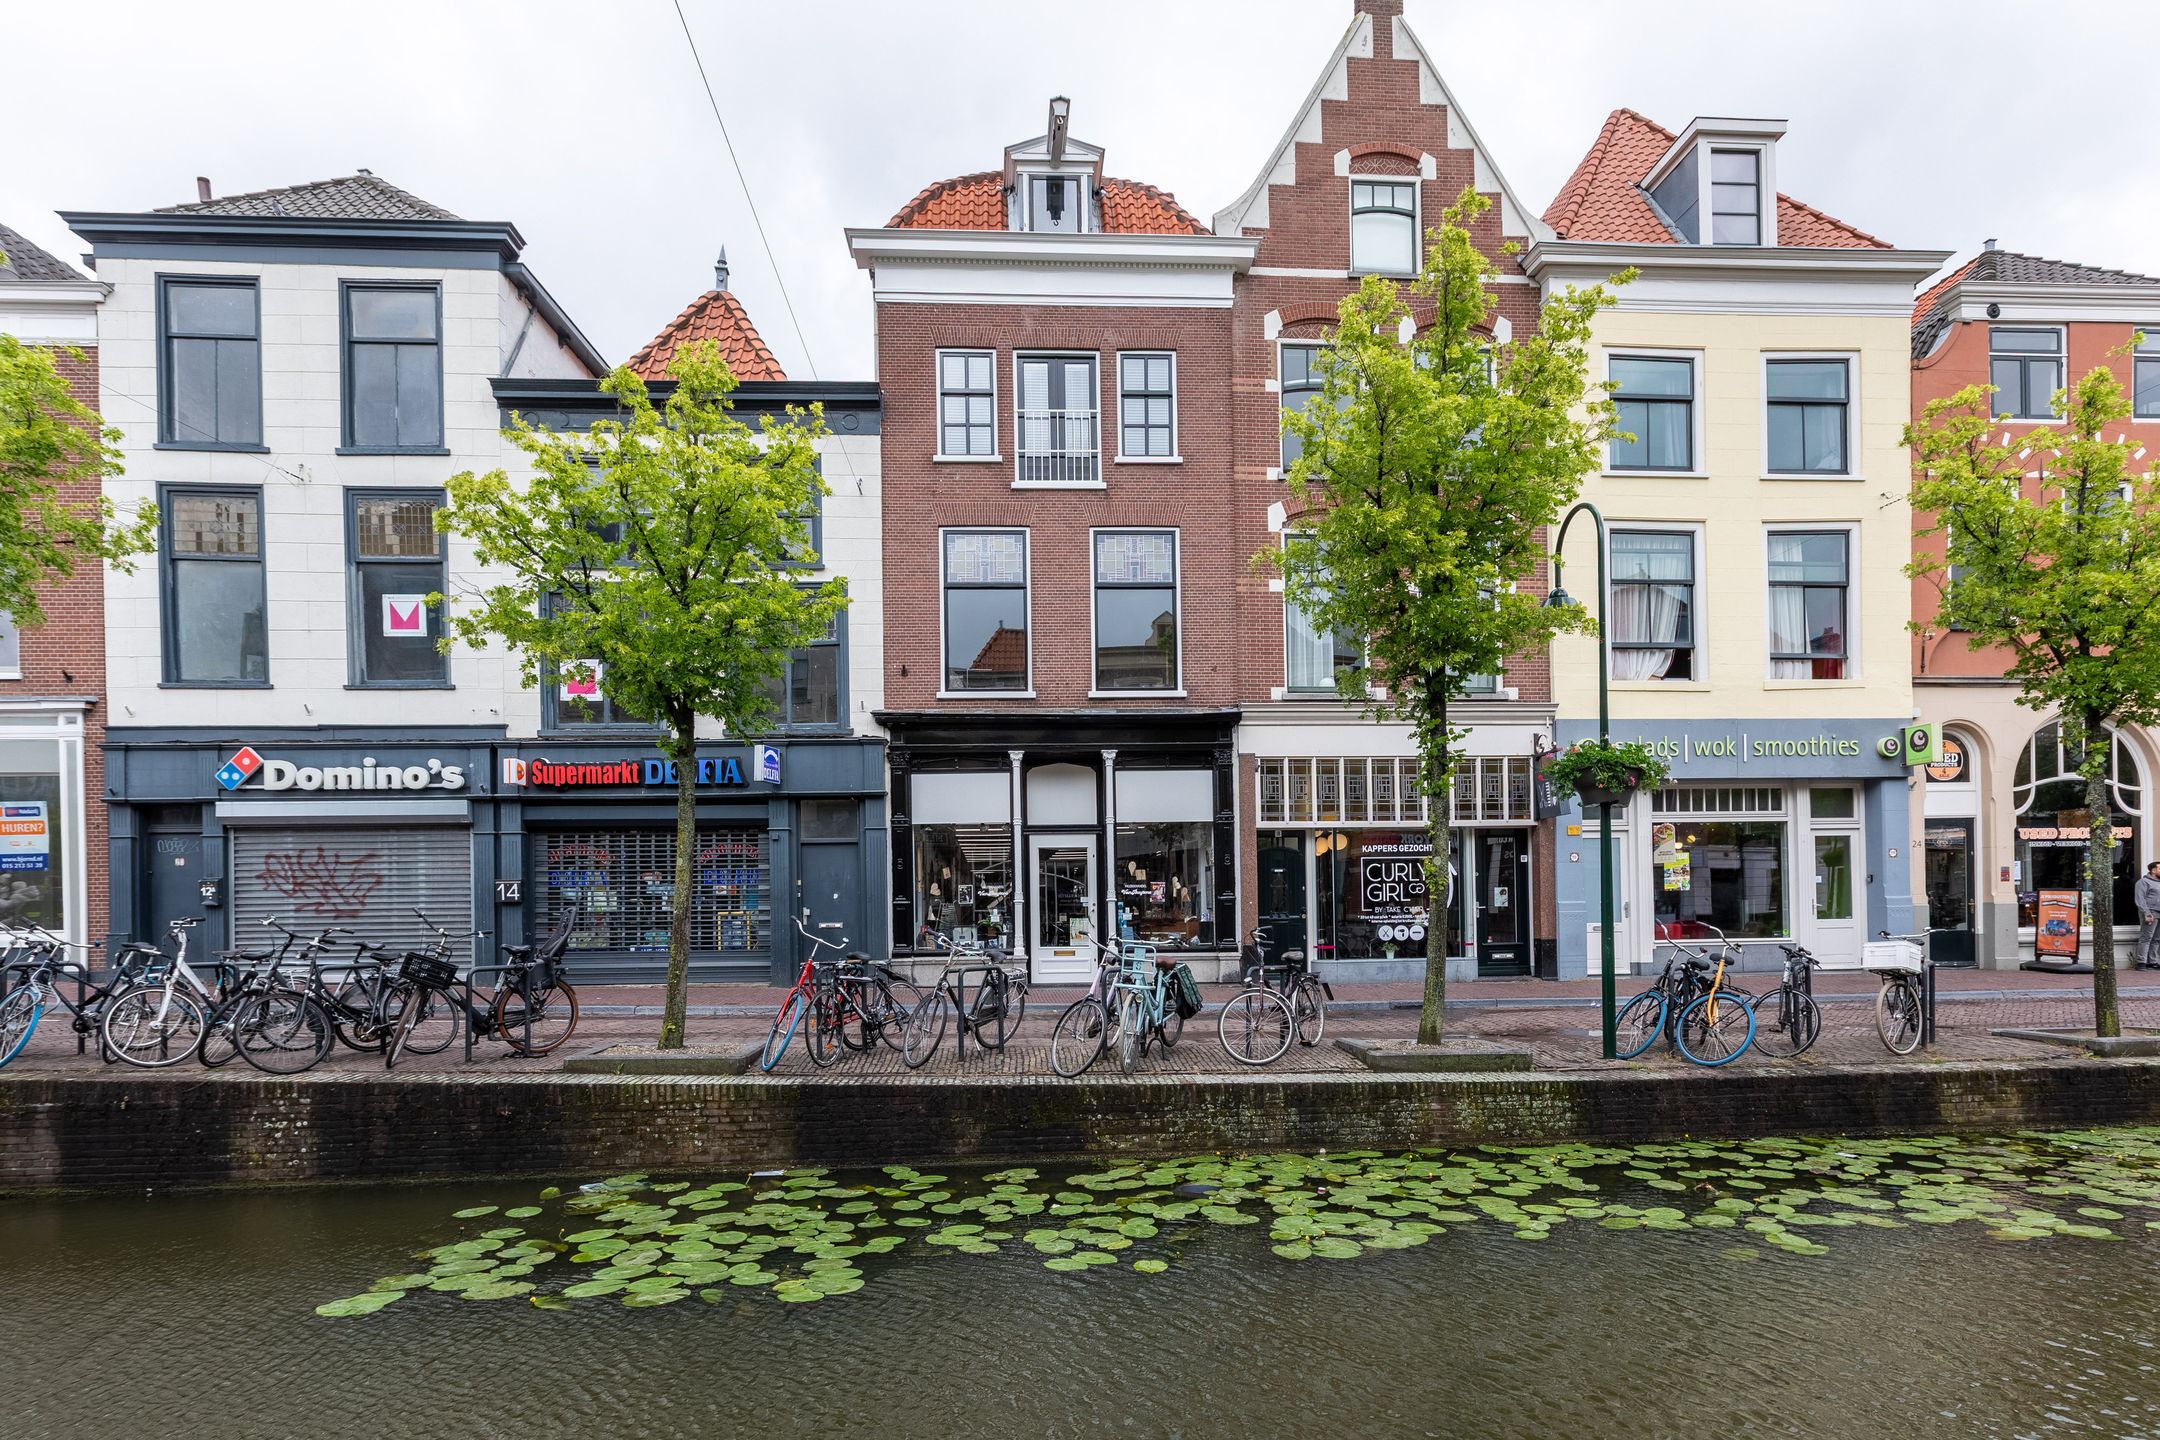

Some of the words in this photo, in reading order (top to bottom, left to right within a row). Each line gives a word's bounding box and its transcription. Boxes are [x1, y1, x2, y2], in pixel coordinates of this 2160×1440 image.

[1694, 735, 1737, 757] wok
[1753, 734, 1860, 757] smoothies
[1943, 753, 1960, 763] ED
[263, 757, 466, 791] Domino's
[531, 760, 640, 787] Supermarkt
[644, 758, 744, 785] DEFIA
[1, 823, 44, 833] HUREN?
[2018, 827, 2058, 840] USED
[2058, 827, 2133, 840] PROTS
[1361, 844, 1398, 853] KAPPERS
[1398, 844, 1433, 852] GEZOCHT
[1912, 840, 1922, 848] 24
[1366, 862, 1426, 882] CURLY
[496, 883, 521, 901] 14
[1366, 882, 1412, 902] GIRL
[1374, 906, 1384, 914] BY
